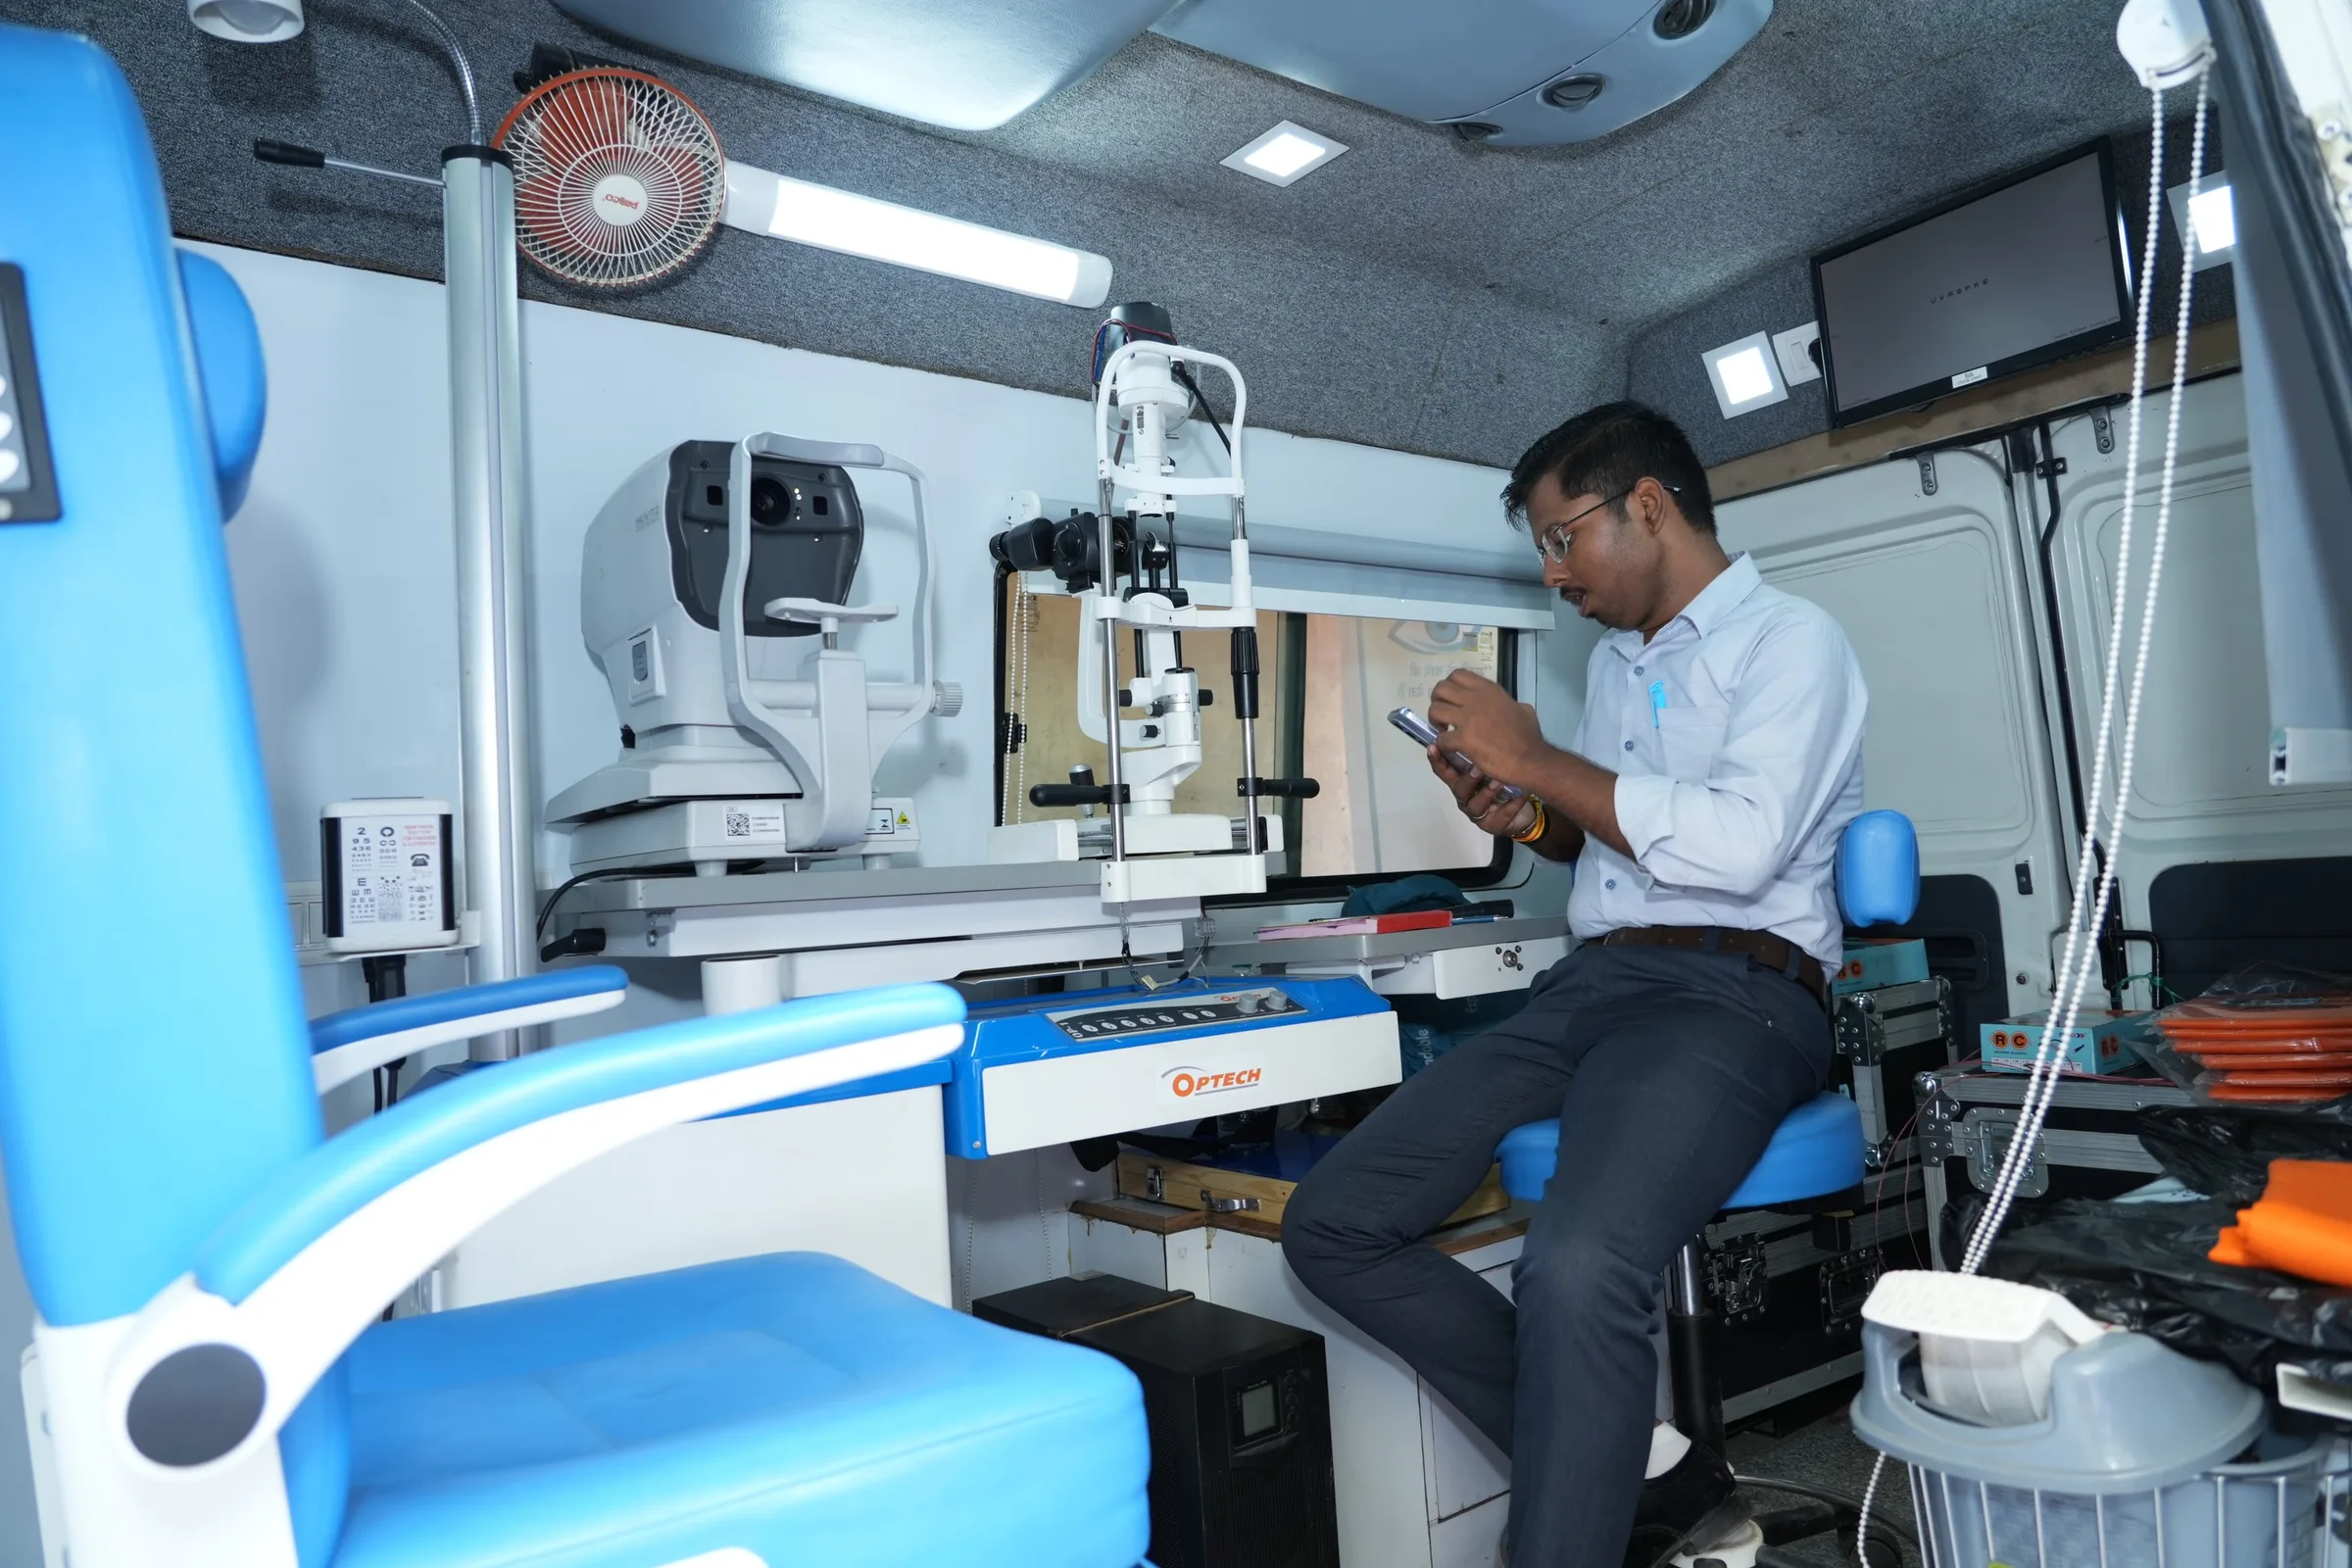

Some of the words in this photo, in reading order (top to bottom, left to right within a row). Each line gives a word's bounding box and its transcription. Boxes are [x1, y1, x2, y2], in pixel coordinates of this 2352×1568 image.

[357, 827, 367, 836] 2
[1059, 1021, 1084, 1039] OP-1
[1173, 1068, 1261, 1098] OPTECH
